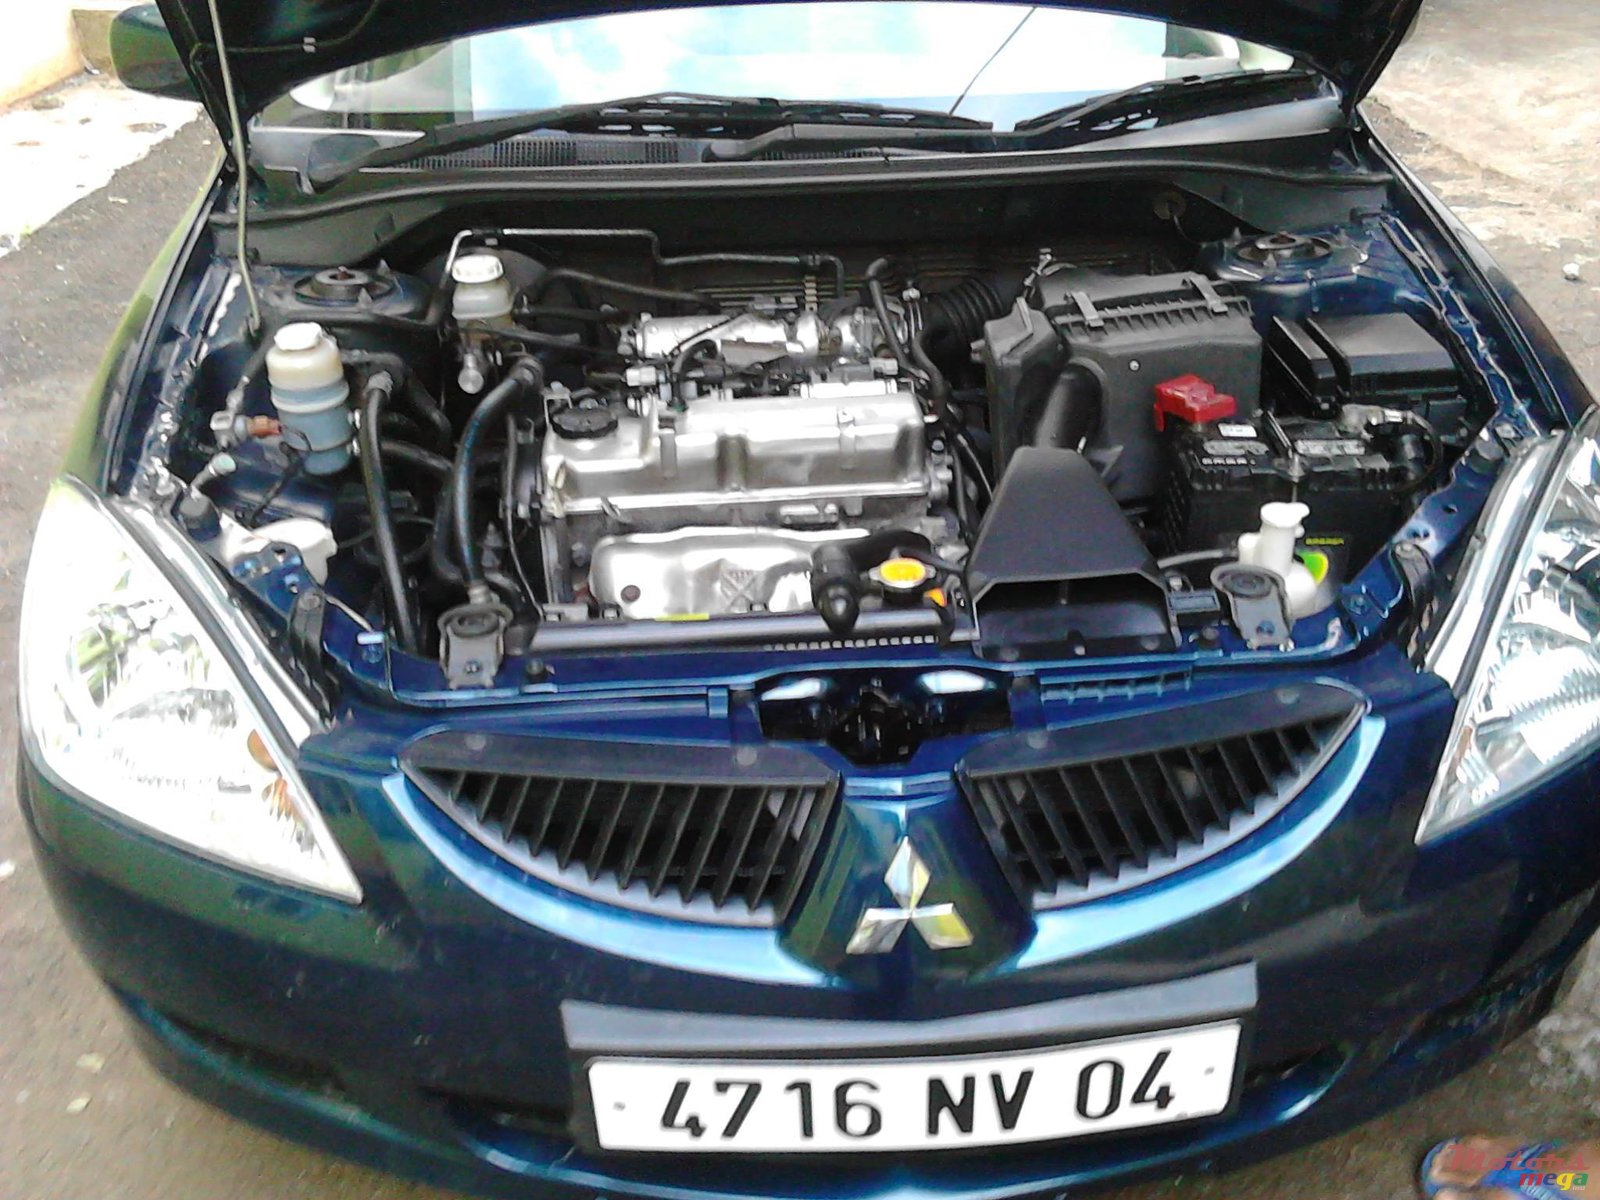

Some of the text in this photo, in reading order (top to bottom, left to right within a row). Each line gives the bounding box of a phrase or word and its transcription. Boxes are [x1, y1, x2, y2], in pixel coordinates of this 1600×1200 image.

[660, 1050, 1175, 1139] 4716 NV 04
